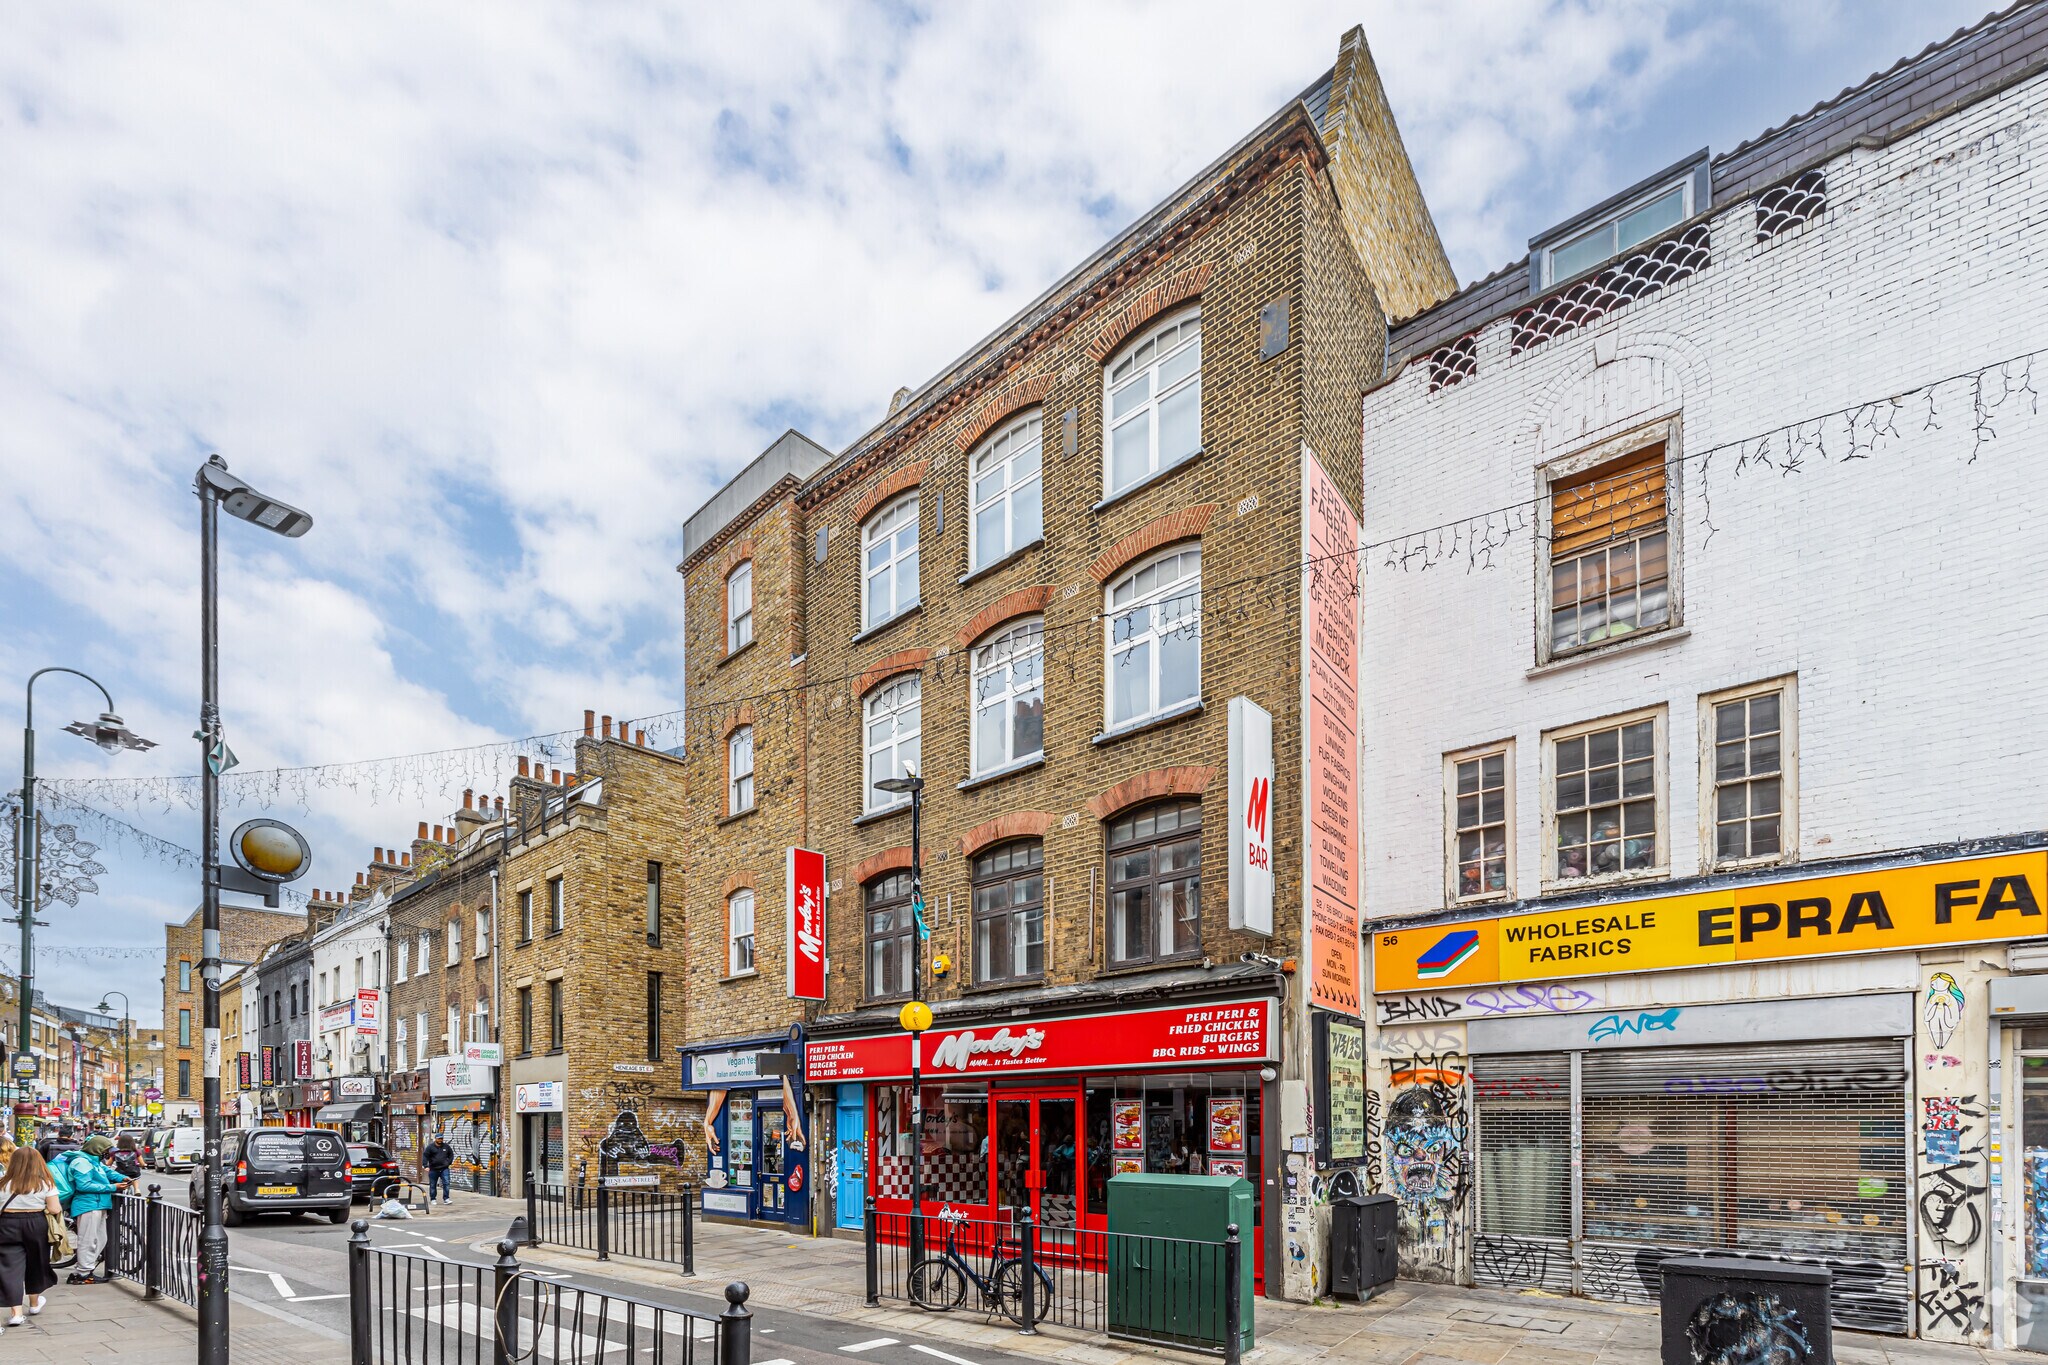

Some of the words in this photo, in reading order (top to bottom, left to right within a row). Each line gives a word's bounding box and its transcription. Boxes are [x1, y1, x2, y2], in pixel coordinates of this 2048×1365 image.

[1321, 477, 1348, 531] EPRA
[1312, 487, 1355, 560] FABRICS
[1326, 526, 1344, 565] LTD
[1311, 586, 1322, 604] OF
[1324, 599, 1355, 645] FASHION
[1318, 612, 1349, 656] FABRICS
[1316, 630, 1324, 649] IN
[1326, 642, 1350, 678] STOCK
[1312, 660, 1328, 683] PLAIN
[1334, 683, 1354, 710] PRINTED
[1323, 688, 1346, 718] COTTONS
[1324, 715, 1346, 744] SUITINGS
[1325, 733, 1345, 759] LININGS
[1319, 746, 1330, 764] FUR
[1331, 756, 1351, 781] FABRICS
[1323, 767, 1347, 795] GINGHAM
[1247, 777, 1268, 843] M
[1323, 784, 1348, 812] WOOLENS
[1321, 801, 1338, 822] DRESS
[1339, 813, 1349, 829] NET
[1249, 842, 1268, 871] BAR
[1322, 838, 1345, 863] QUILTING
[1320, 854, 1348, 881] TOWELLING
[1322, 873, 1347, 897] WADDING
[797, 884, 822, 963] Morley's
[1312, 910, 1327, 923] PHONE
[1698, 891, 1894, 947] EPRA
[1935, 874, 2042, 925] FA
[1315, 924, 1324, 936] FAX
[1383, 935, 1398, 946] 56
[1506, 912, 1656, 943] WHOLESALE
[1331, 949, 1342, 960] OPEN
[1530, 938, 1632, 963] FABRICS
[1322, 969, 1331, 979] SUN
[1332, 971, 1350, 986] MORNING
[1169, 1024, 1202, 1035] FRIED
[1205, 1019, 1259, 1032] CHICKEN
[1186, 1012, 1212, 1022] PERI
[1216, 1009, 1244, 1020] PERI
[1248, 1008, 1259, 1017] &
[932, 1028, 1042, 1071] Morley's
[1152, 1047, 1176, 1057] BBQ
[1180, 1046, 1206, 1056] RIBS
[1218, 1042, 1259, 1054] WINGS
[1202, 1031, 1259, 1043] BURGERS
[727, 1057, 745, 1067] Vegan
[810, 1061, 837, 1069] BURGERS
[827, 1052, 854, 1060] CHICKEN
[842, 1067, 864, 1075] WINGS
